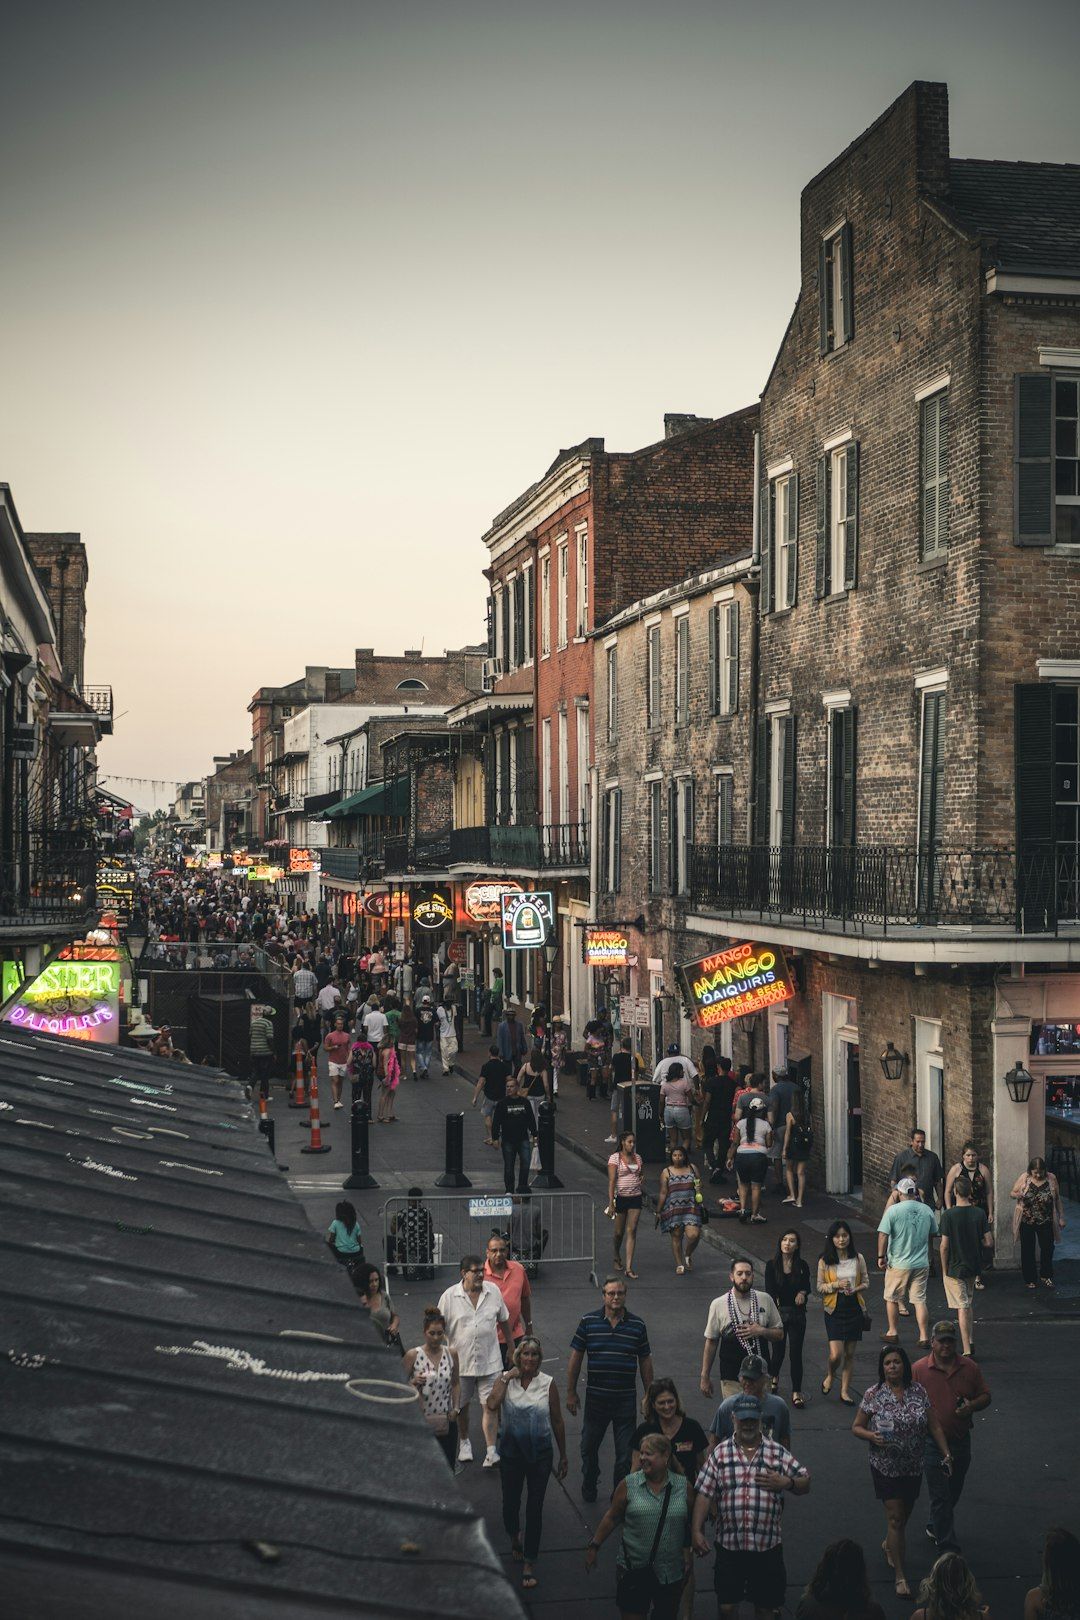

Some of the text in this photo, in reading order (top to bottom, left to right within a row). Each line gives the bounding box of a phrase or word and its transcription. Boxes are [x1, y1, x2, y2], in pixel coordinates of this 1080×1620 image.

[504, 894, 551, 922] BEER FEST
[587, 939, 628, 949] MANGO
[593, 932, 620, 940] MANGO
[702, 945, 752, 972] MANGO
[693, 952, 776, 998] MANGO
[702, 971, 776, 1005] DAIQUIRIS
[702, 981, 786, 1017] COCKTAILS & BEER
[703, 1009, 726, 1026] PIZZA
